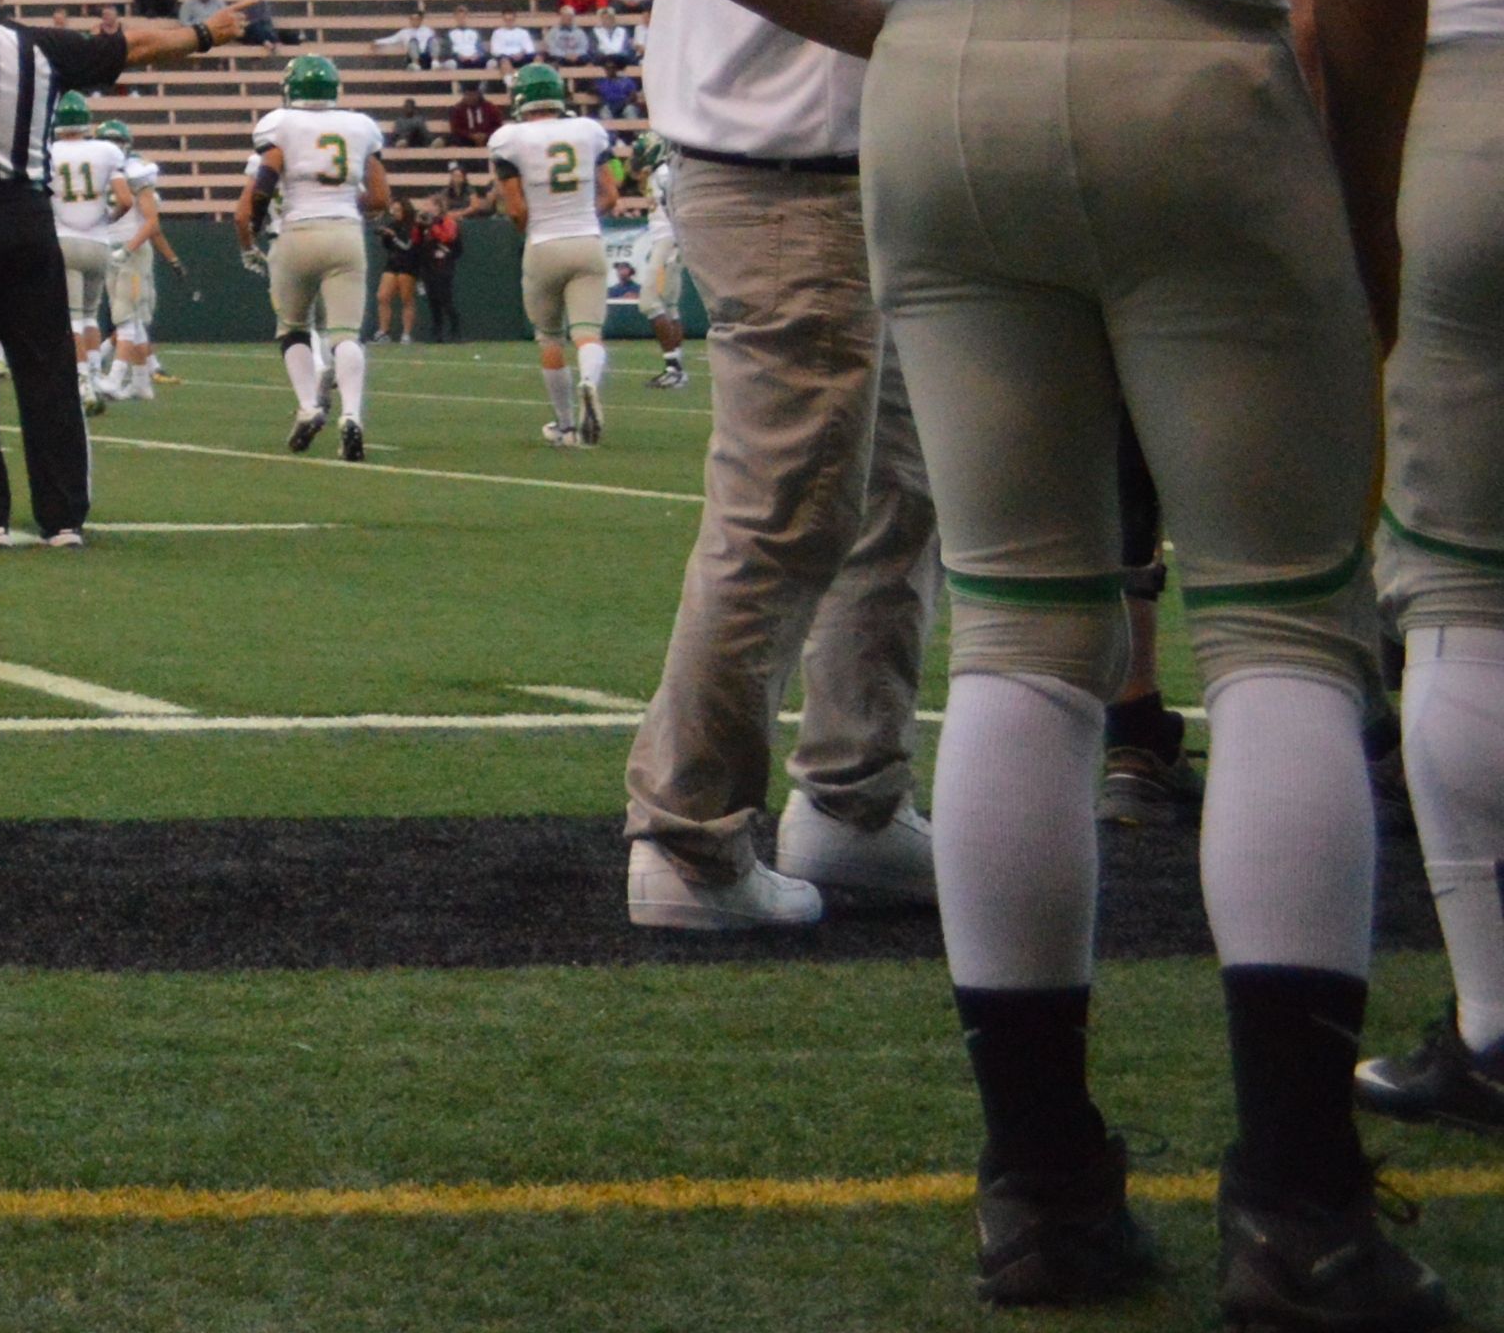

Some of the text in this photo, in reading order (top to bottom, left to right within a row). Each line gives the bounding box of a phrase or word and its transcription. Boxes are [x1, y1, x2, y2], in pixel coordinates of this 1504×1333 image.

[58, 161, 101, 203] 11
[316, 132, 349, 187] 3
[546, 141, 579, 194] 2
